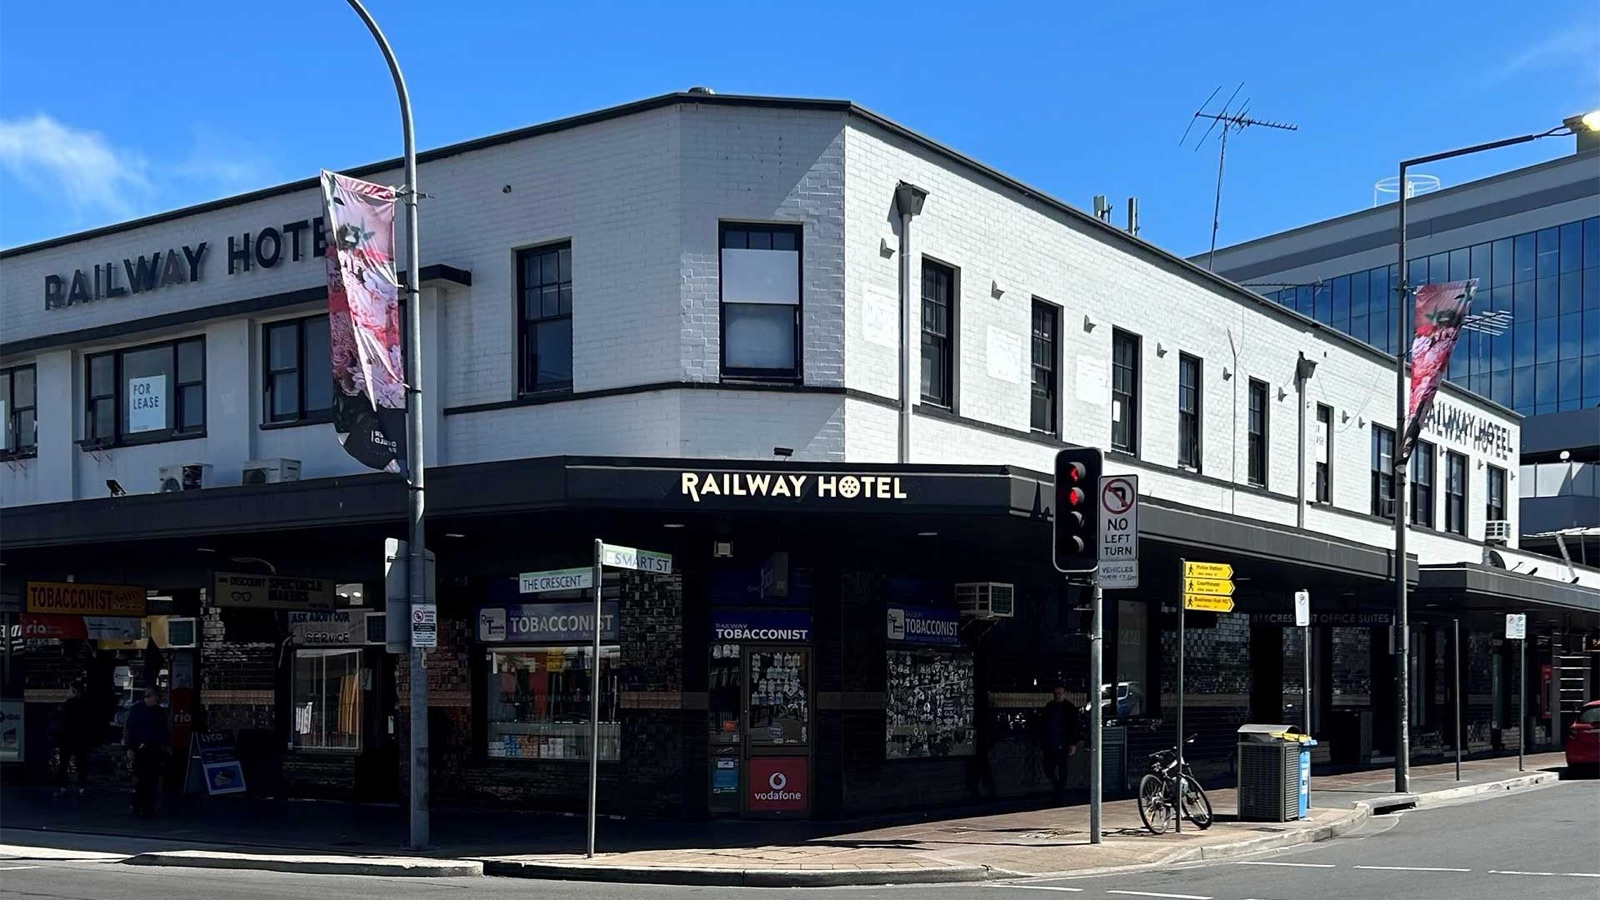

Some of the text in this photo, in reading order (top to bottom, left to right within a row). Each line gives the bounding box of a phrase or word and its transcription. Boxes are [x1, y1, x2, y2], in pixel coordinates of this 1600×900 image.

[44, 218, 328, 310] RAILWAY HOTE
[132, 383, 150, 395] FOR
[132, 396, 159, 410] LEASE
[1424, 401, 1514, 454] AILWAY HOTEL
[682, 472, 908, 502] RAILWAY HOTEL
[1107, 518, 1128, 531] NO
[1105, 534, 1131, 544] LEFT
[1104, 546, 1133, 556] TURN
[613, 552, 670, 572] SMART ST
[1102, 566, 1134, 574] VEHICLES
[522, 575, 582, 592] THE CRESCENT
[30, 586, 113, 609] TOBACCONIST
[291, 611, 350, 623] ASK ABOUT OUR
[510, 614, 615, 633] TOBACCONIST
[1320, 613, 1356, 623] OFFICE
[1357, 613, 1390, 623] SUITES
[715, 628, 809, 640] TOBACCONIST
[905, 618, 959, 637] TOBACCONIST
[306, 632, 350, 643] SERVICE
[754, 791, 802, 801] vodafone
